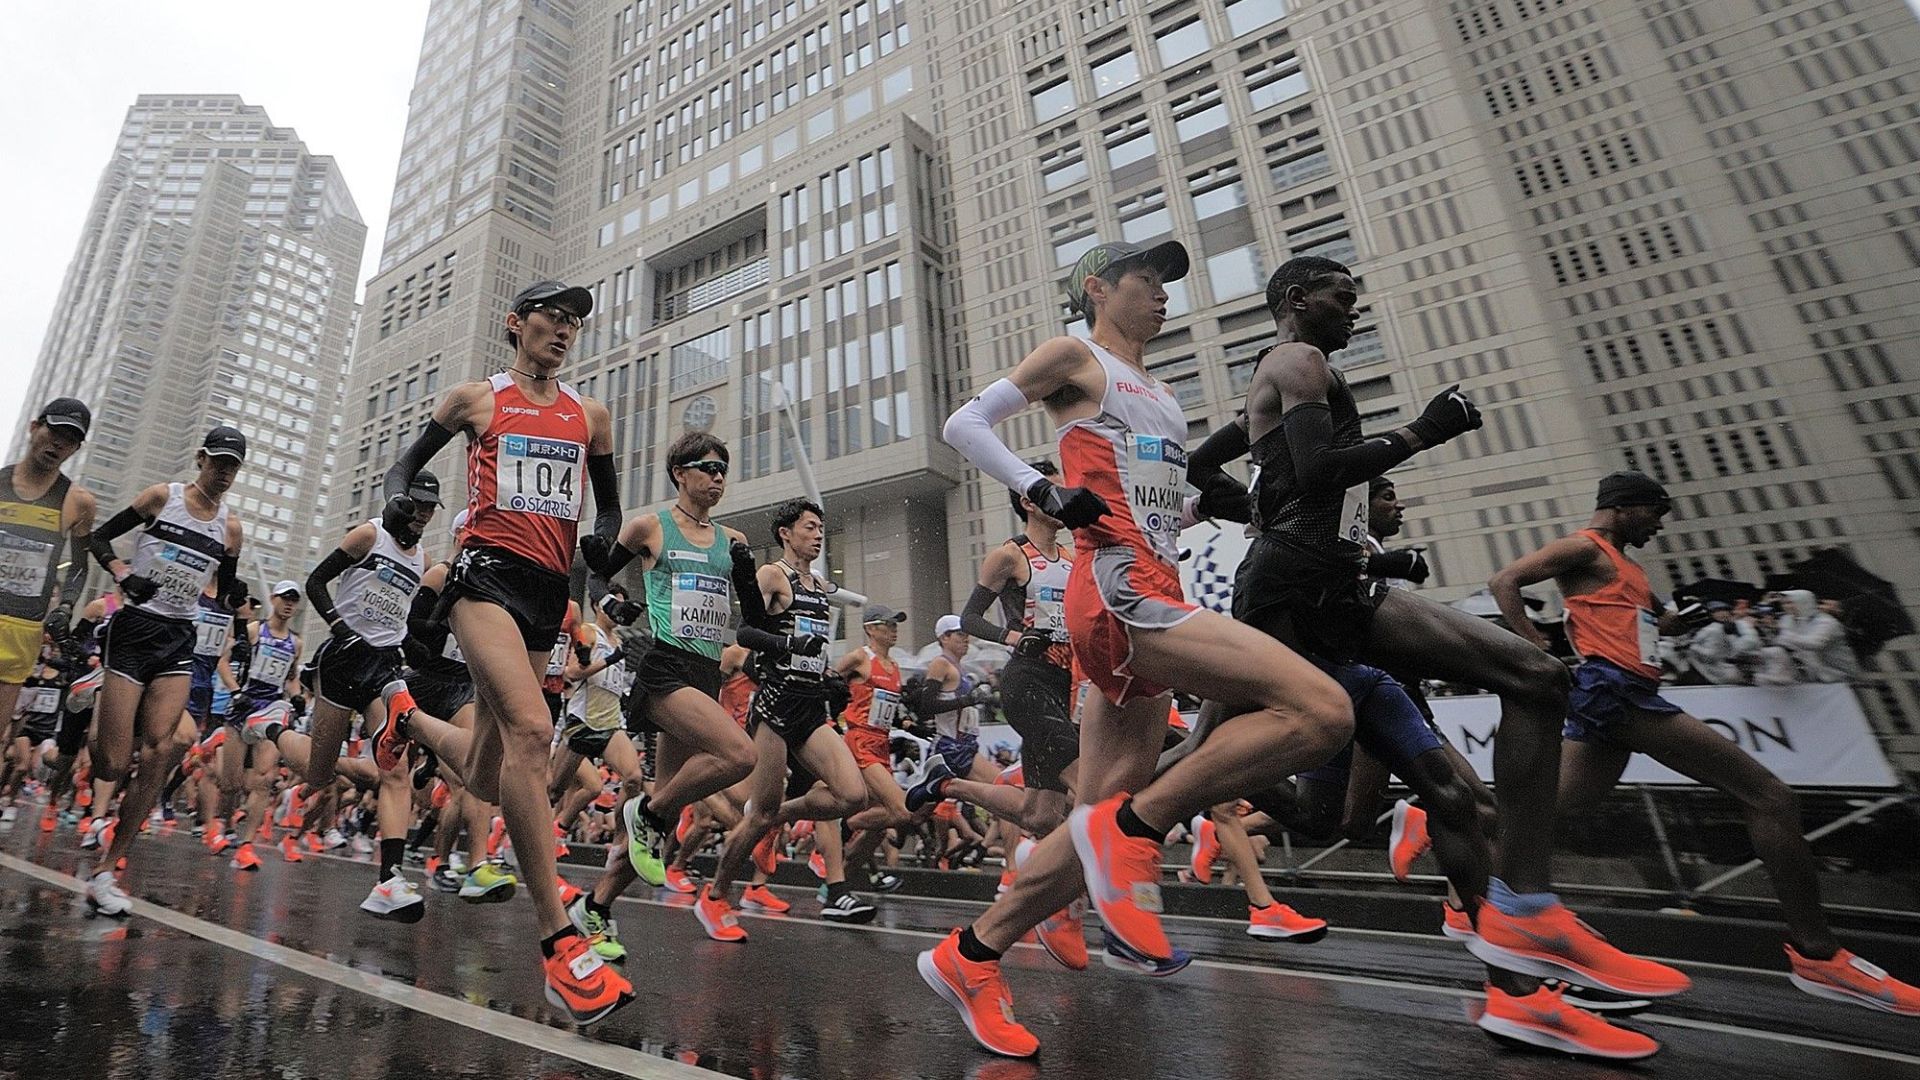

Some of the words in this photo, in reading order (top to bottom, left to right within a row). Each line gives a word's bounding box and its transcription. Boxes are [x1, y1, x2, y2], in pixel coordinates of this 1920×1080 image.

[1116, 382, 1159, 401] FUJITSU
[529, 442, 577, 459] 東京メトロ
[516, 460, 573, 501] 104
[1168, 467, 1178, 486] 23
[527, 497, 571, 518] STARTS
[702, 594, 715, 608] 28
[680, 606, 727, 627] KAMINO
[261, 657, 287, 679] 153
